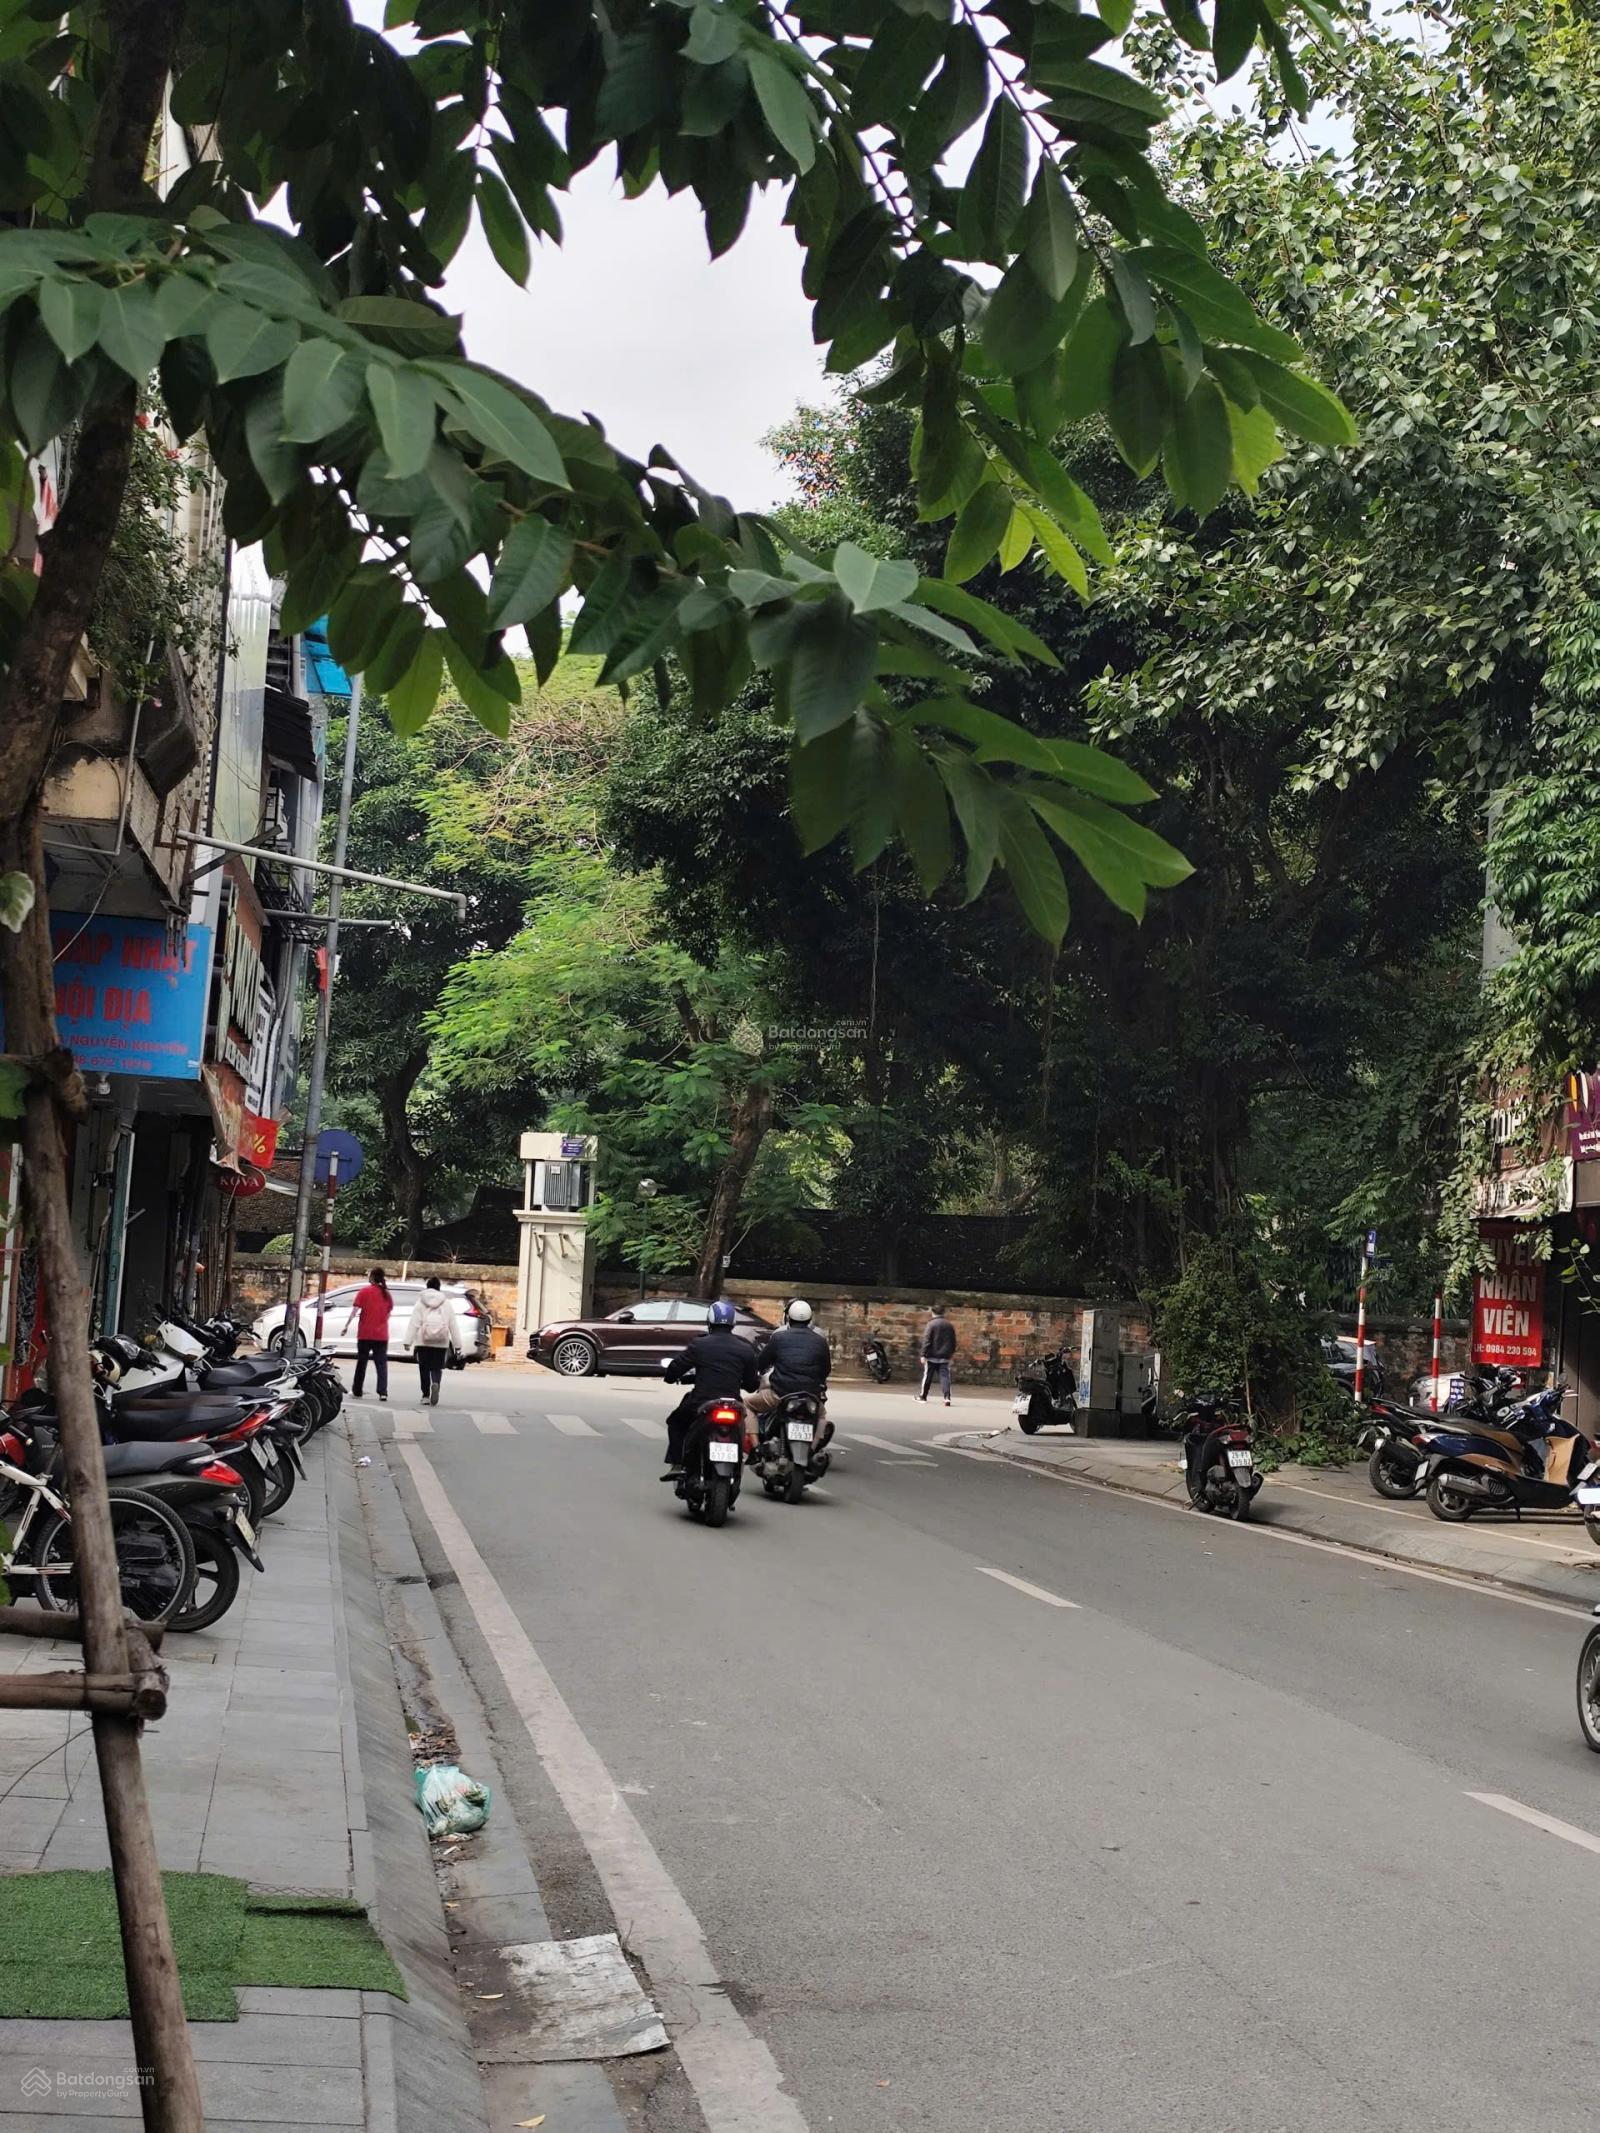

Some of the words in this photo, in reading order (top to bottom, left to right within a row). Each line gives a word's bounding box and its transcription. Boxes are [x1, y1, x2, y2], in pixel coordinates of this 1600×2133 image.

[104, 987, 152, 1030] ĐỊA
[1479, 1269, 1537, 1302] NHÂN
[1483, 1304, 1530, 1337] VIÊN
[1486, 1344, 1504, 1354] 0984
[1507, 1345, 1521, 1355] 230
[1522, 1347, 1537, 1357] 594
